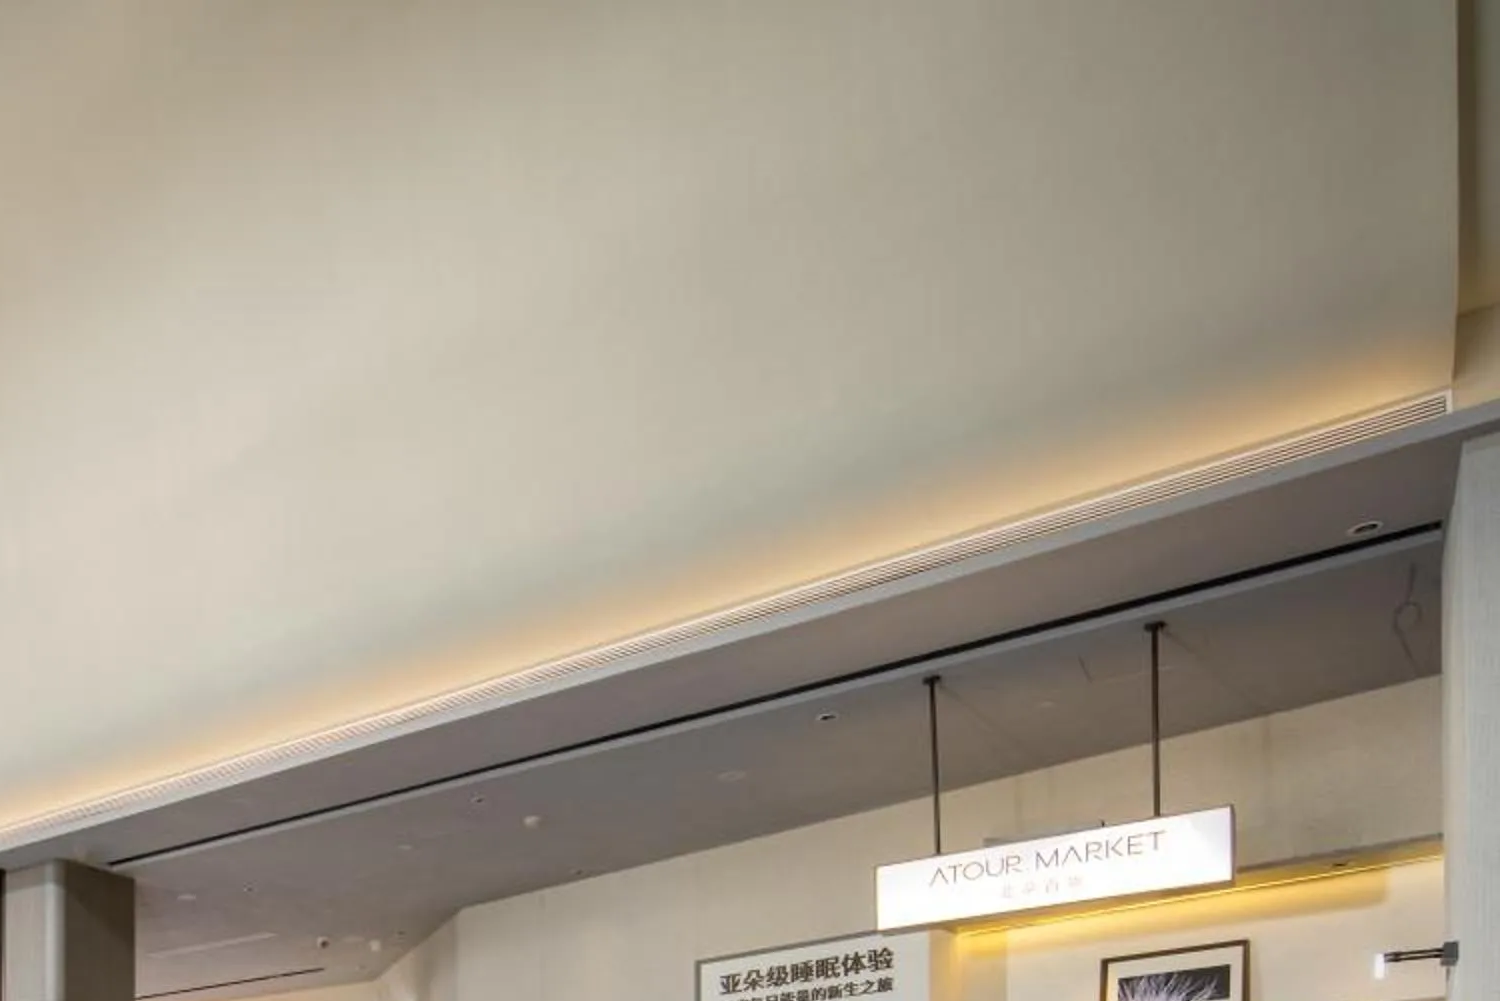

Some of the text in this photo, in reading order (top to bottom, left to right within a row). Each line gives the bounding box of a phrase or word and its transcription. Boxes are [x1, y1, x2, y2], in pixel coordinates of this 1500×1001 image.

[929, 830, 1167, 887] ATOUR MARKET
[719, 947, 895, 995] 亚朵级睡眠体验
